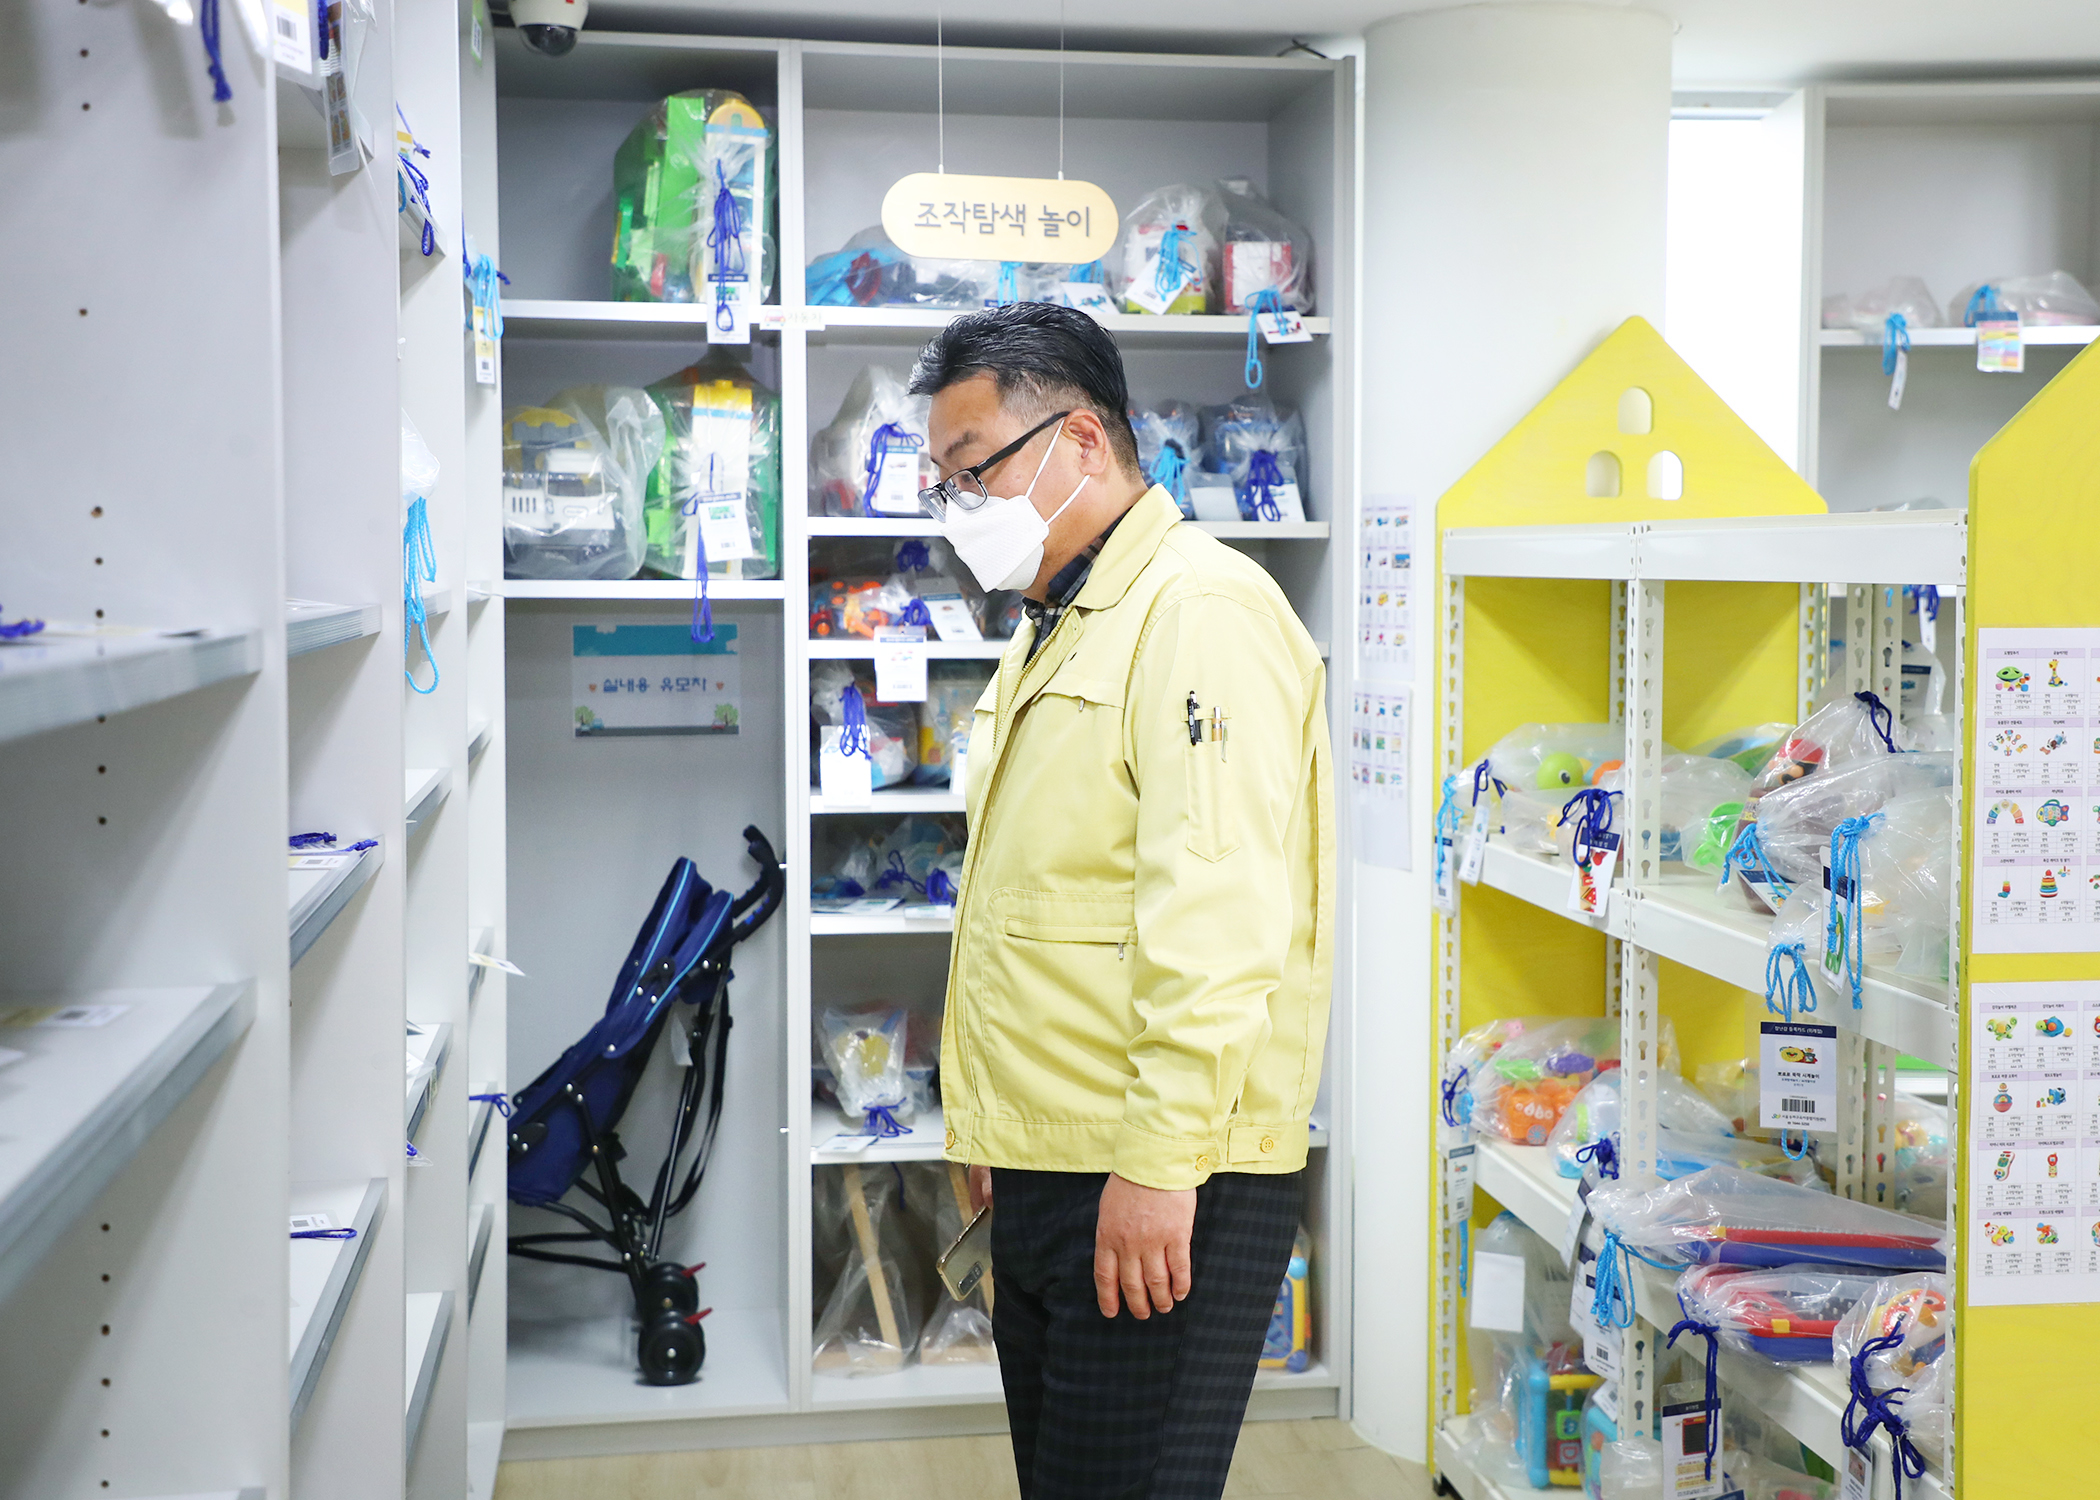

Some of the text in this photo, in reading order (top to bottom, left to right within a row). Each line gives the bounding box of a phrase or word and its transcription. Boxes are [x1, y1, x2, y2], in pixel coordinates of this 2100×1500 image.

[914, 201, 1091, 238] 조작탐색 놀이
[603, 676, 707, 693] 실내용 유모차
